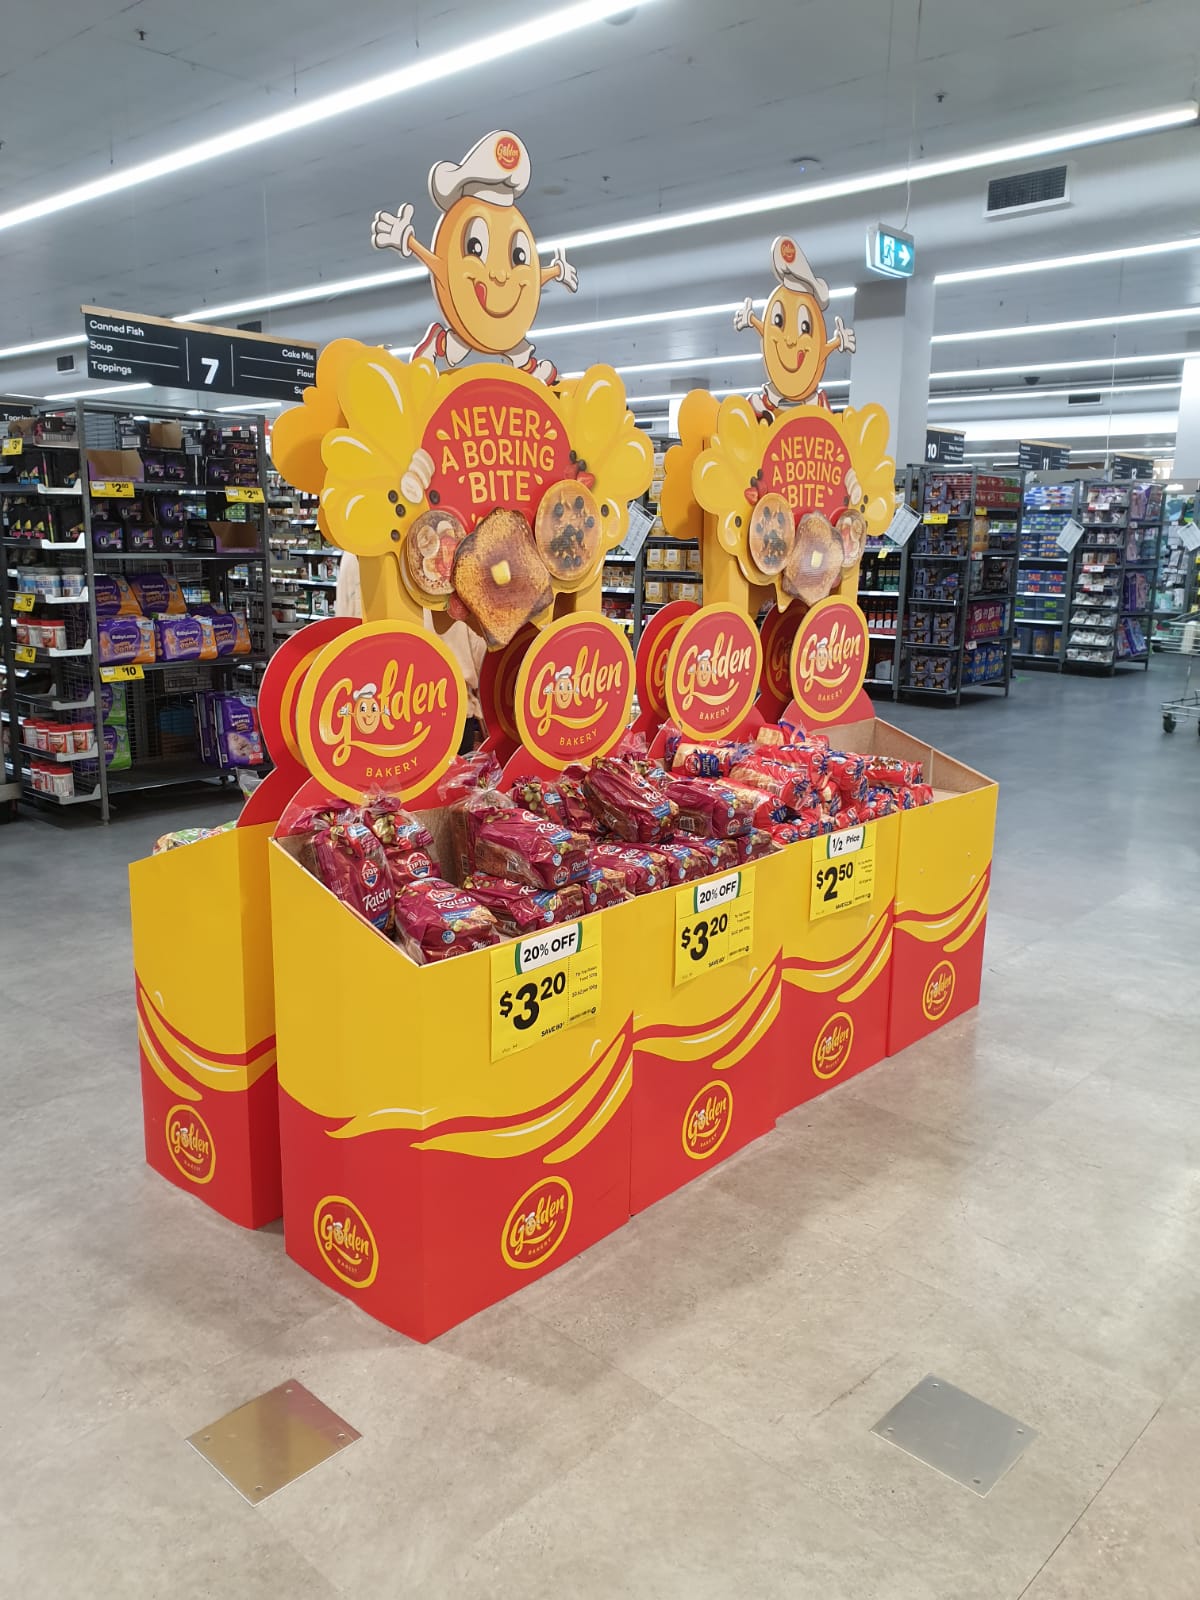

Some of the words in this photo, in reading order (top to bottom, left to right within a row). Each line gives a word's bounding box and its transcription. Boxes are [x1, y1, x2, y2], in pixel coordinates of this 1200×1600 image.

[89, 320, 125, 334] Canned
[126, 326, 144, 336] Fish
[90, 340, 113, 353] Soup
[282, 349, 301, 359] Cake
[301, 352, 314, 361] Mix
[91, 360, 132, 375] Toppings
[201, 357, 219, 384] 7
[296, 369, 315, 379] Flour
[451, 405, 541, 440] NEVER
[442, 446, 460, 475] A
[462, 438, 555, 472] BORING
[780, 436, 834, 462] NEVER
[927, 443, 937, 459] 10
[772, 465, 783, 487] A
[785, 460, 842, 485] BORING
[468, 470, 531, 504] BITE
[787, 483, 826, 508] BITE
[800, 621, 862, 693] Golden
[122, 666, 137, 677] $10
[677, 631, 752, 711] Golden
[530, 645, 623, 737] Golden
[817, 688, 843, 701] BAKERY
[318, 659, 448, 767] Golden
[699, 706, 730, 720] BAKERY
[560, 728, 598, 746] BAKERY
[365, 756, 418, 778] BAKERY
[846, 833, 860, 844] Price
[362, 887, 392, 911] Raisin
[434, 896, 477, 909] Raisin
[699, 887, 718, 904] 20%
[719, 880, 737, 896] OFF
[523, 942, 549, 962] 20%
[551, 932, 576, 953] OFF
[817, 1026, 849, 1068] Golden
[687, 1095, 727, 1147] Golden
[170, 1121, 209, 1159] Golden
[320, 1213, 369, 1259] Golden
[510, 1194, 565, 1256] Golden
